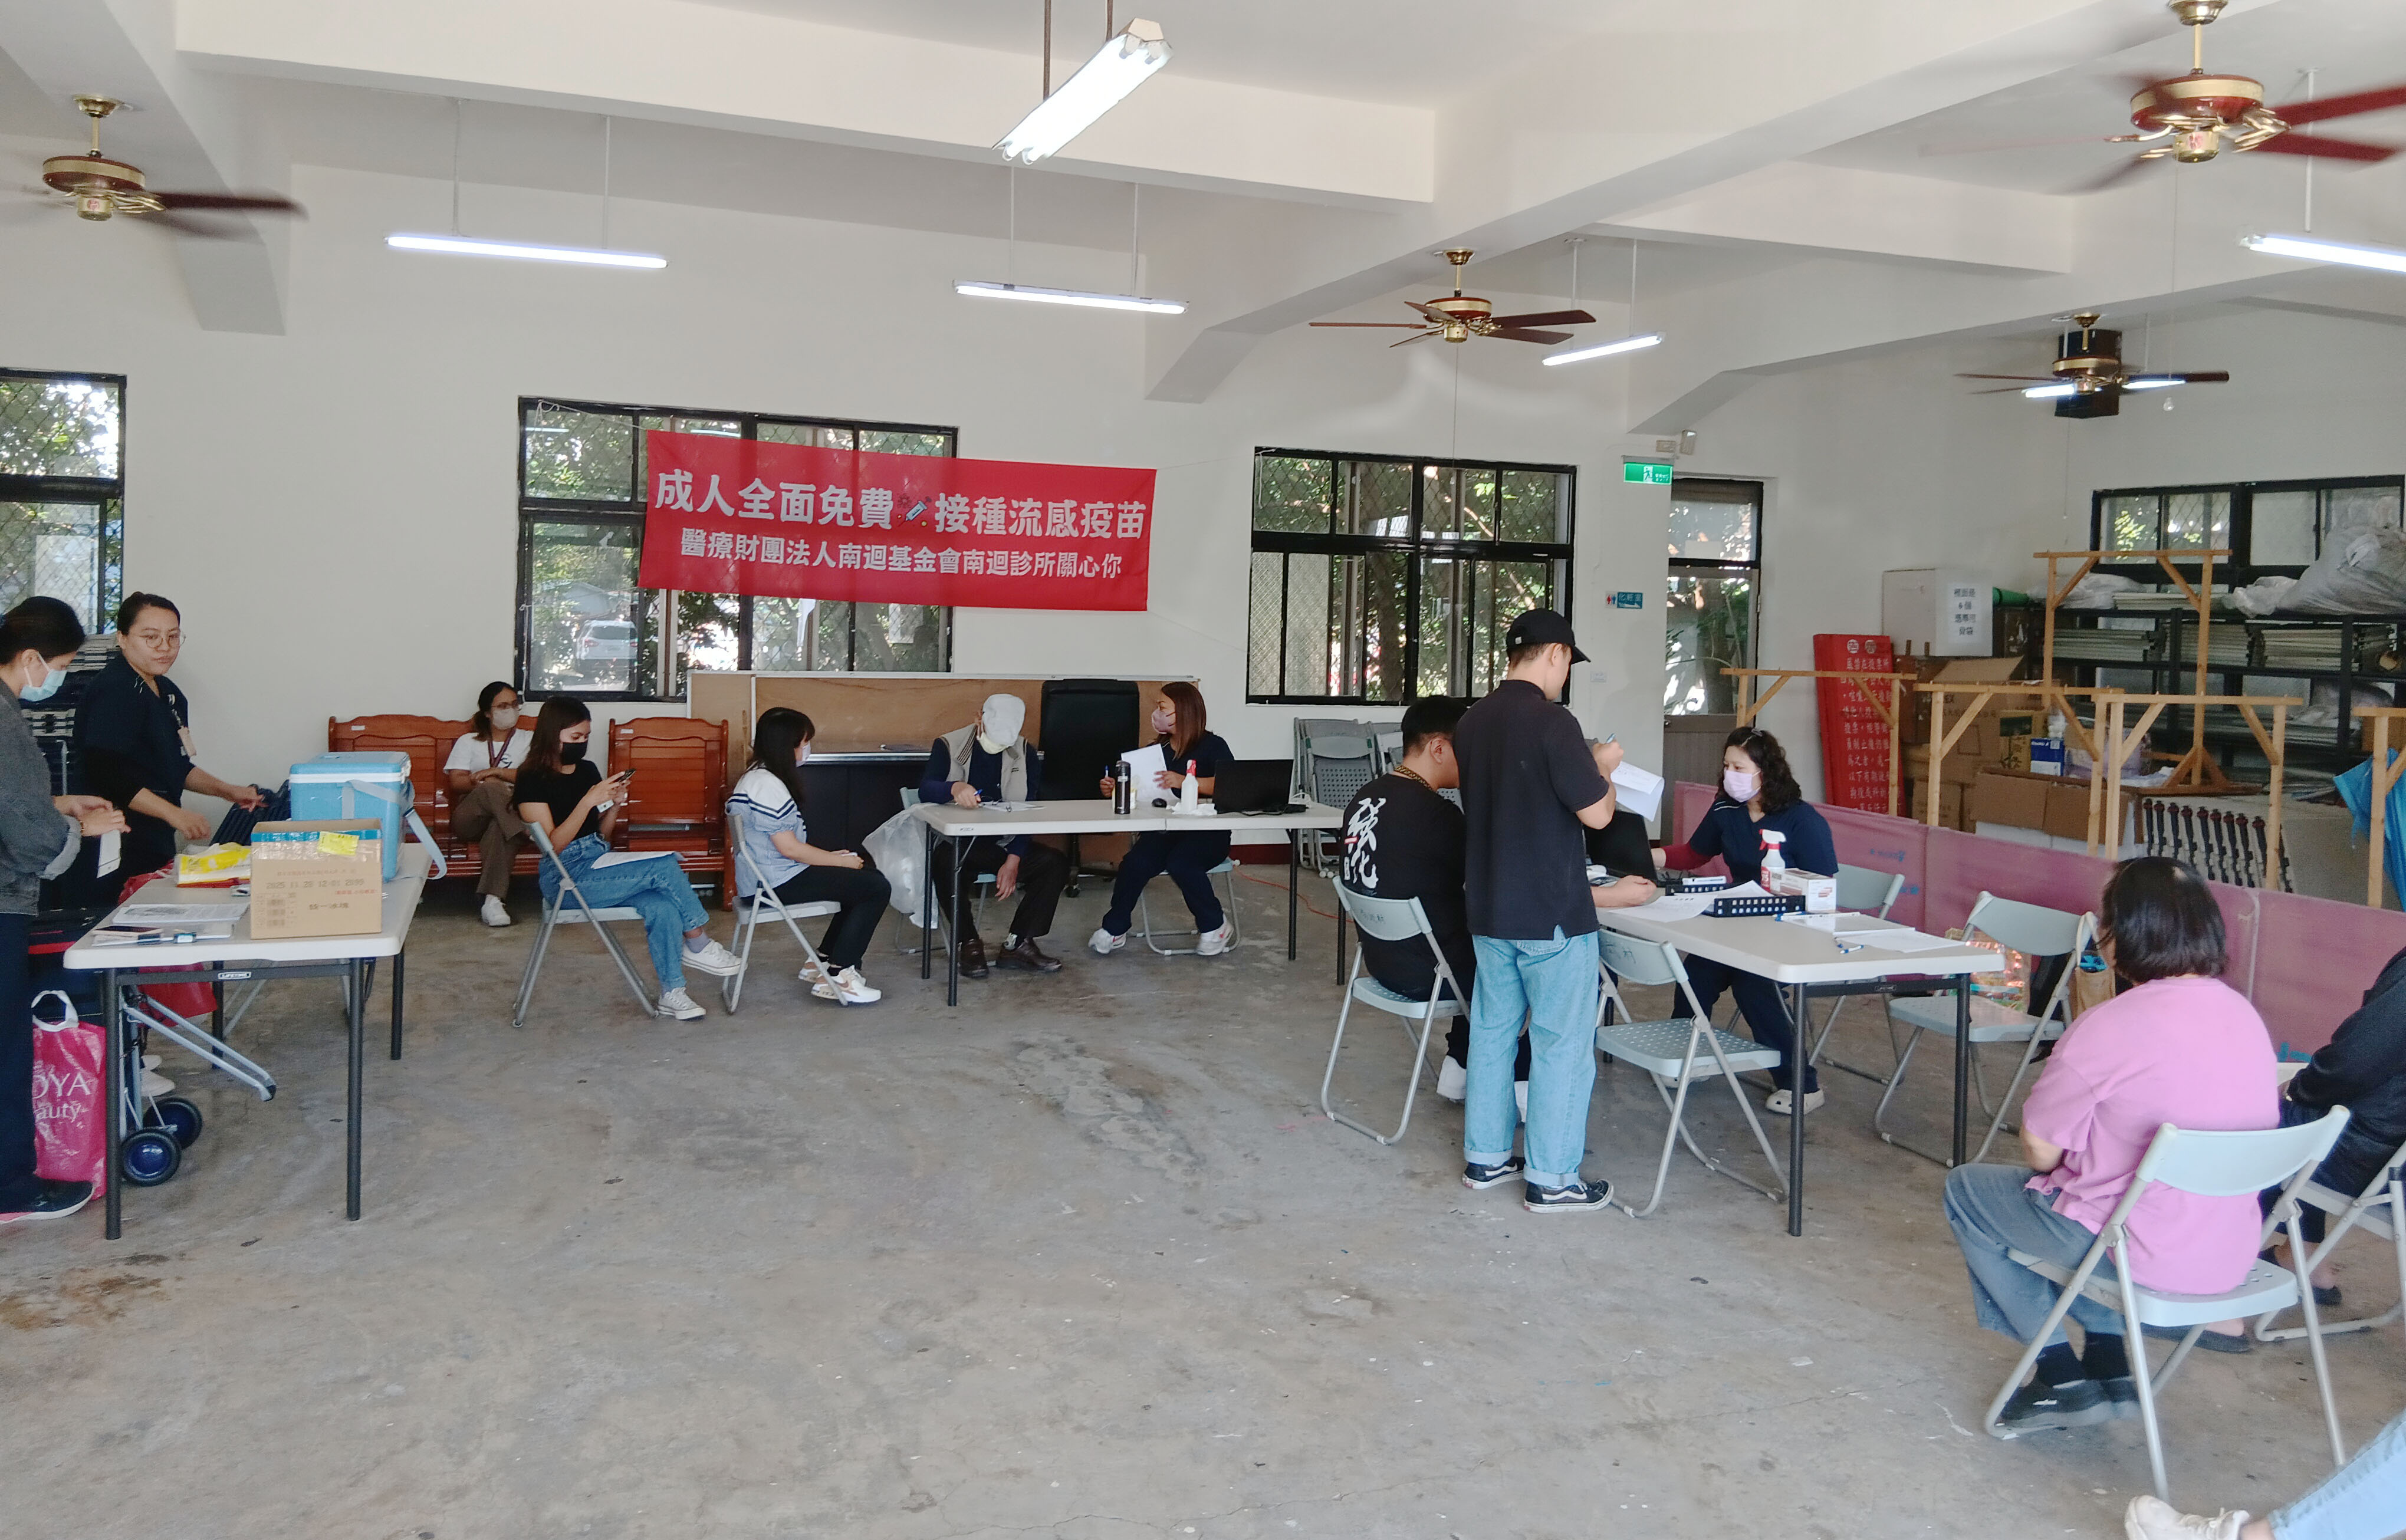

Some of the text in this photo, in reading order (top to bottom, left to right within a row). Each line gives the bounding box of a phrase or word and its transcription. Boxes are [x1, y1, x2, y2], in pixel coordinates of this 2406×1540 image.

[655, 469, 1146, 539] 成人全面免費 接種流感疫苗
[681, 528, 1122, 578] 醫療財團法人南迴基金會南迴診所關心你
